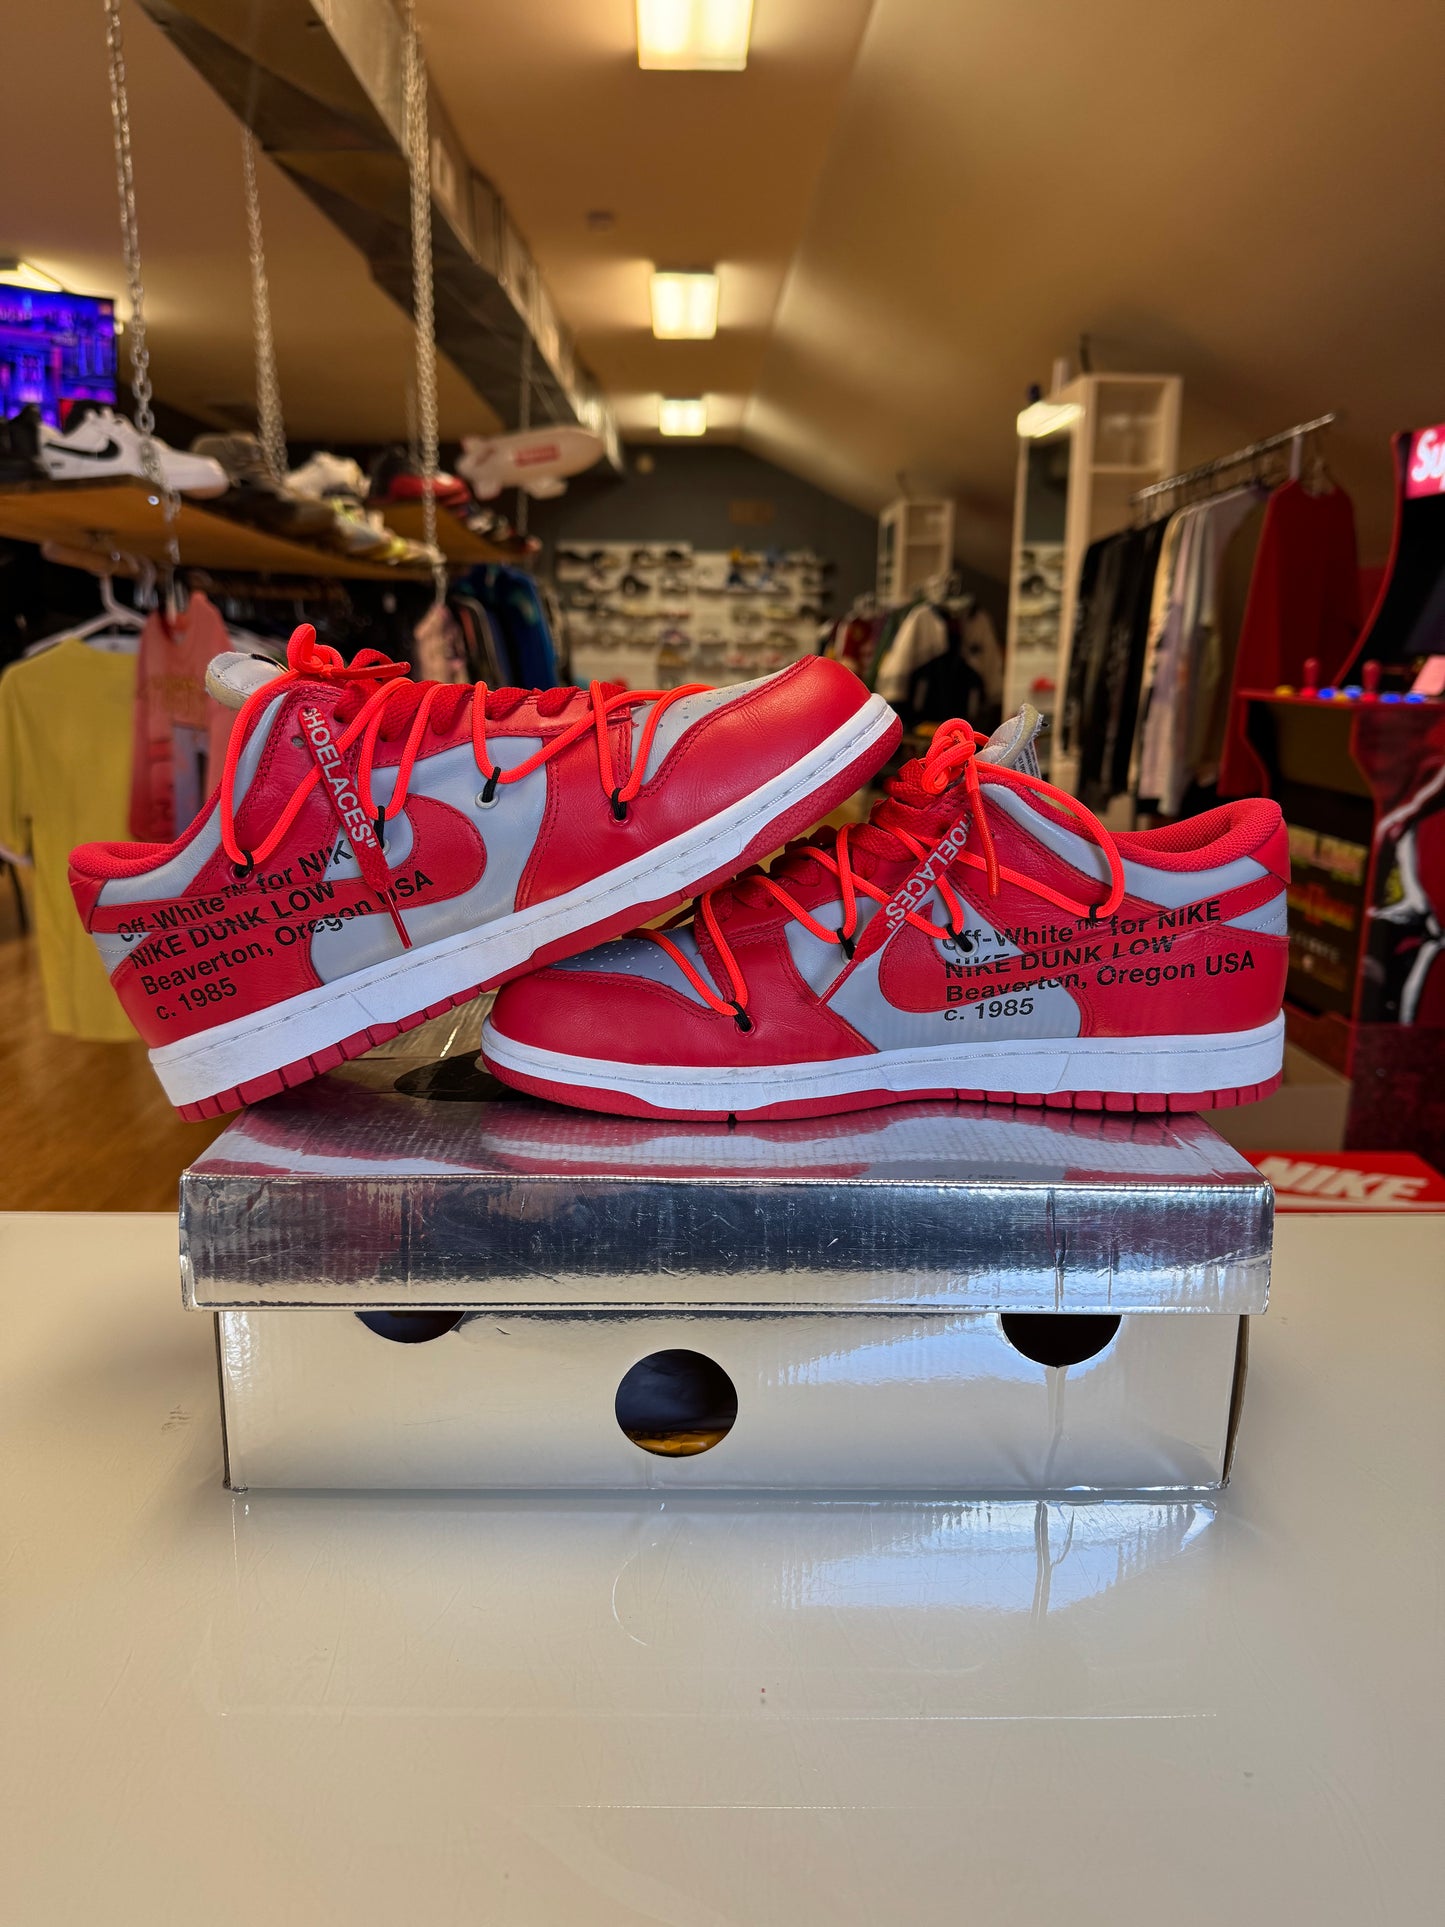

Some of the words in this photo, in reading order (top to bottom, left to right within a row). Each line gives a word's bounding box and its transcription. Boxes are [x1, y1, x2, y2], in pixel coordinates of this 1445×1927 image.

[1410, 428, 1445, 492] Su
[256, 867, 293, 894] for
[297, 839, 353, 877] NIK
[128, 934, 187, 969] NIKE
[188, 907, 268, 948] DUNK
[271, 882, 336, 918] LOW
[1109, 915, 1149, 936] for
[1158, 900, 1221, 929] NIKE
[141, 942, 274, 995] Beaverton,
[275, 901, 374, 946] Oregon
[945, 953, 1012, 978] NIKE
[1021, 945, 1102, 970] DUNK
[1112, 934, 1177, 959] LOW
[156, 1005, 177, 1020] c.
[178, 976, 238, 1011] 1985
[946, 973, 1087, 1002] Beaverton,
[1096, 963, 1195, 986] Oregon
[1205, 950, 1255, 976] USA
[944, 1009, 965, 1021] c.
[975, 998, 1034, 1019] 1985
[1256, 1155, 1431, 1200] NIKE
